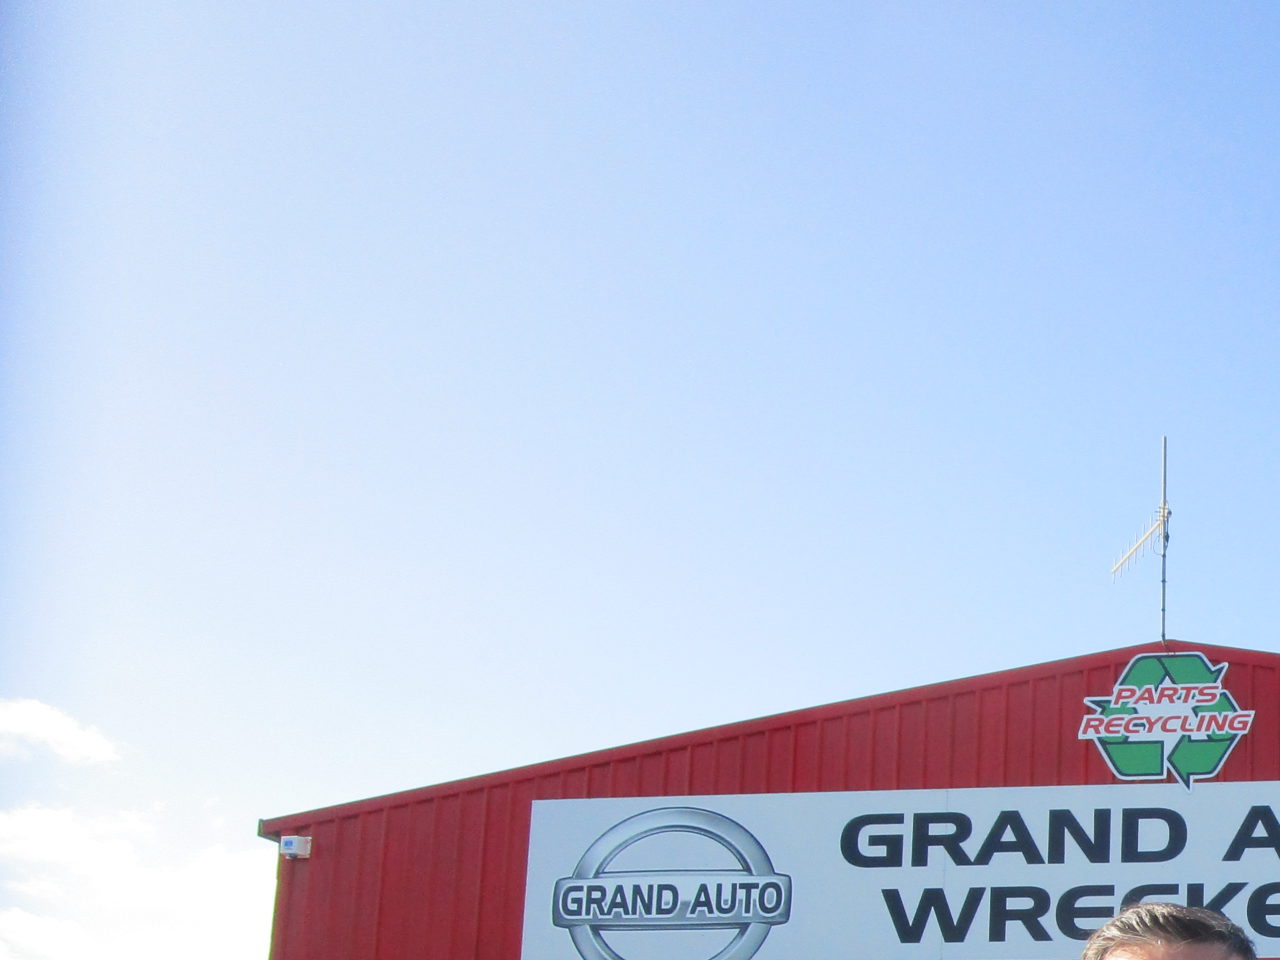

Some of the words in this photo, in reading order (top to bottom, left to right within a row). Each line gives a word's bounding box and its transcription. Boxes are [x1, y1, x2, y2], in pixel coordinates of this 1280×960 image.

[1113, 685, 1220, 706] PARTS
[1081, 713, 1252, 735] RECYCLING
[839, 808, 1188, 868] GRAND
[561, 883, 680, 917] GRAND
[689, 881, 784, 915] AUTO
